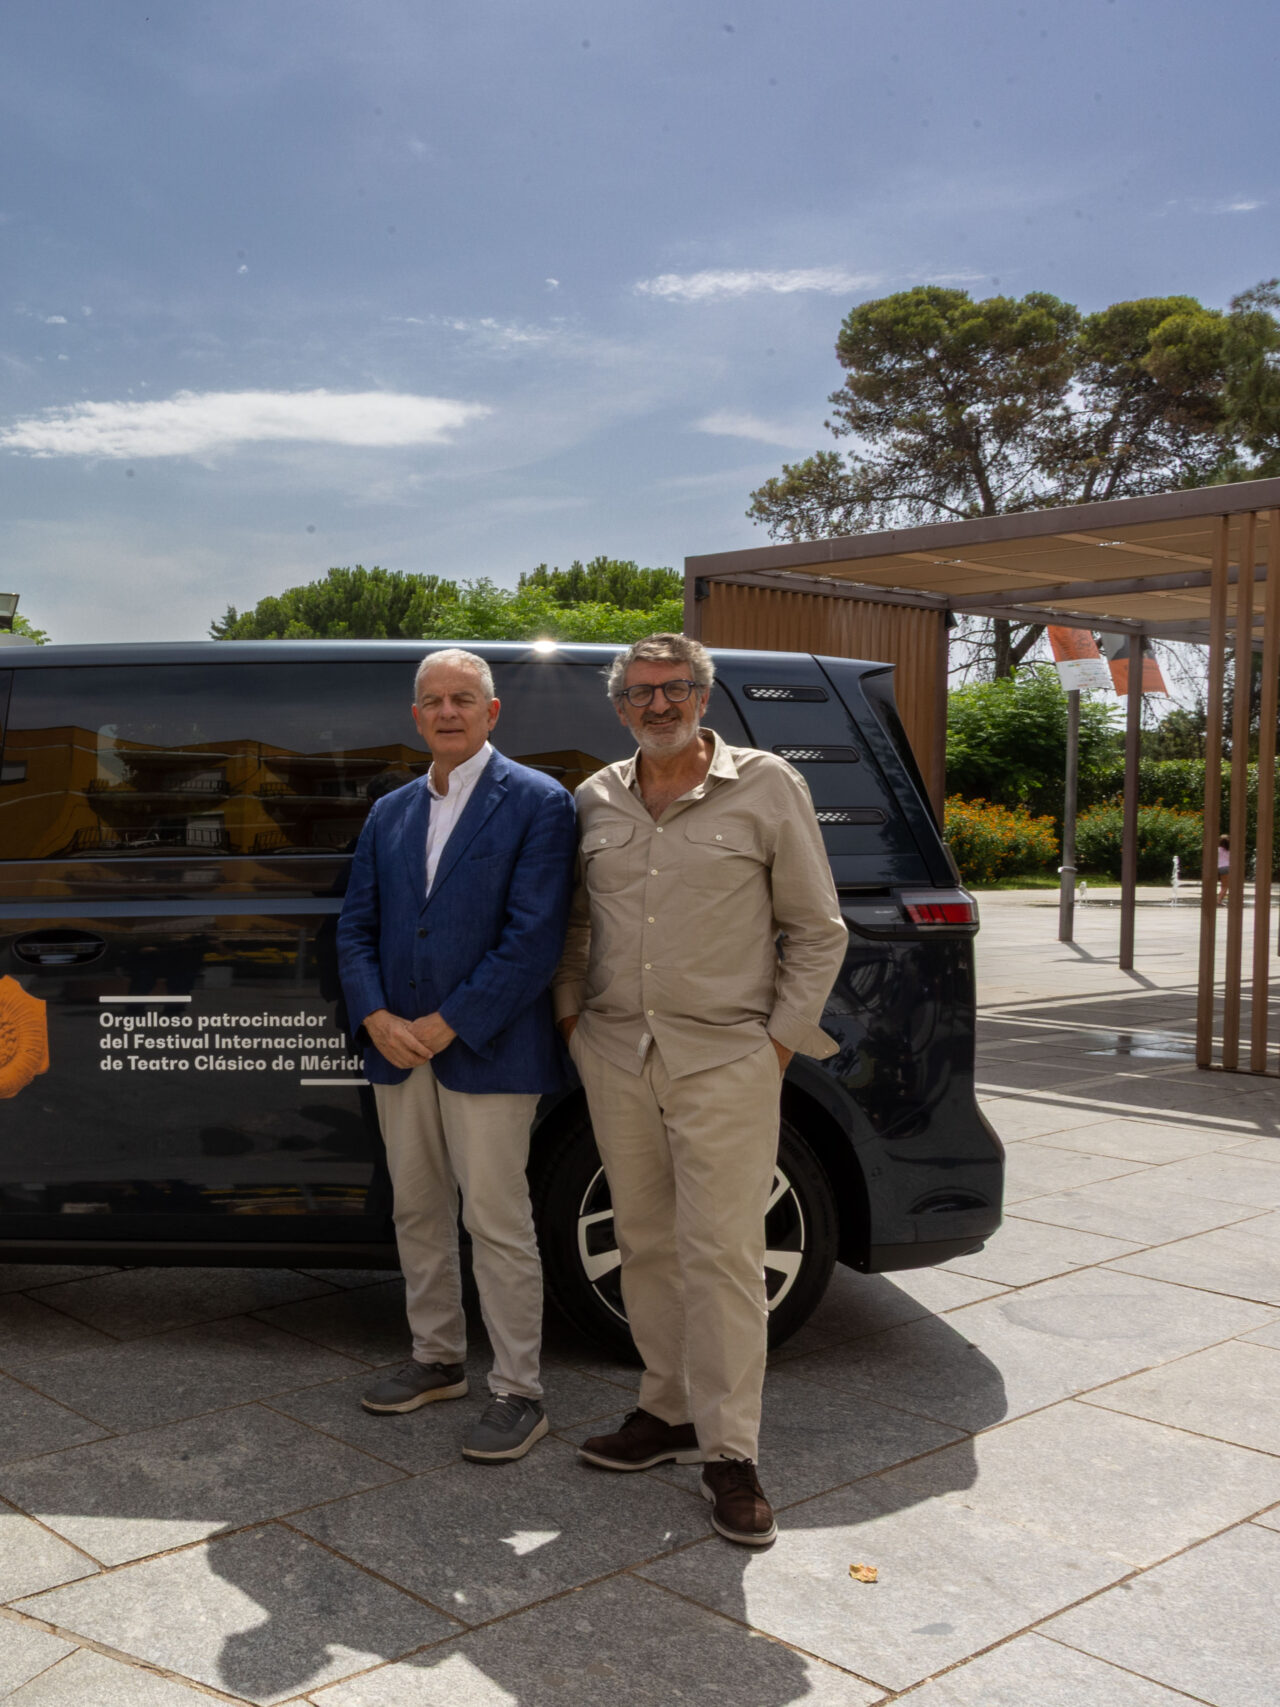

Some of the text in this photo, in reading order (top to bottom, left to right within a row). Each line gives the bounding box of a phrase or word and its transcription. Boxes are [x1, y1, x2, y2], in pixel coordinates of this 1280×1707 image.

[99, 1011, 327, 1031] Orgulloso patrocinador
[100, 1033, 346, 1049] del Festival Internacional
[100, 1055, 123, 1070] de
[127, 1055, 190, 1070] Teatro
[194, 1055, 267, 1070] Clásico
[272, 1055, 295, 1070] de
